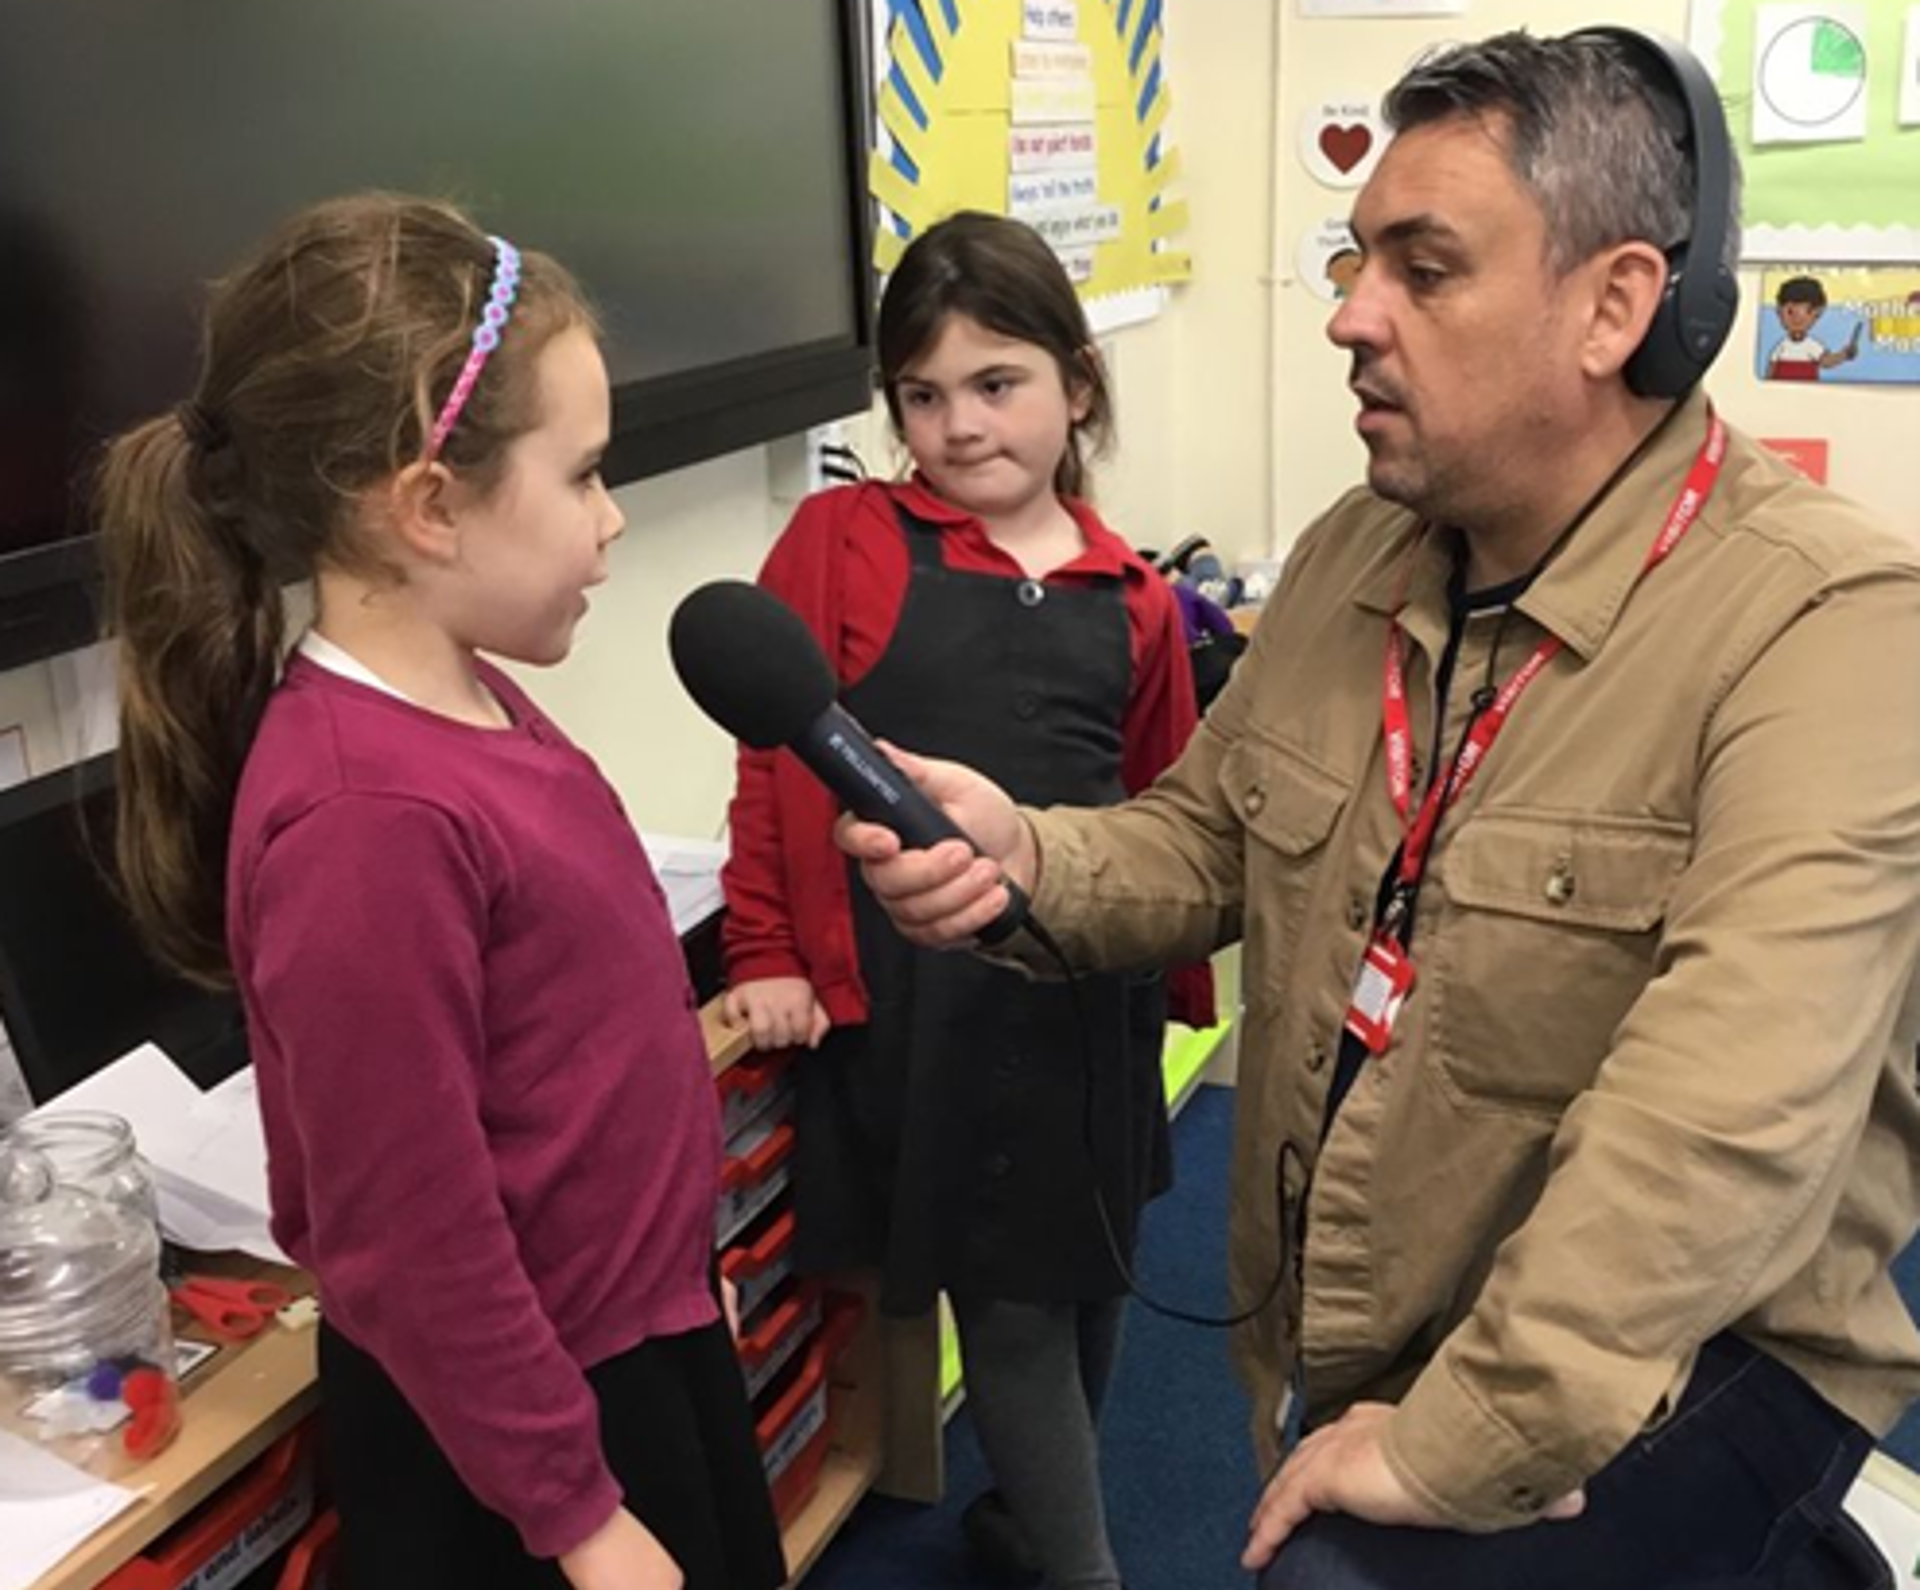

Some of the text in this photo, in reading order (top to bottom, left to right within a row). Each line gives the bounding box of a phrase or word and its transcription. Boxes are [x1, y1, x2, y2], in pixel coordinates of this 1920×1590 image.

[1322, 104, 1370, 117] Be Kind
[1388, 729, 1406, 798] VISITOR
